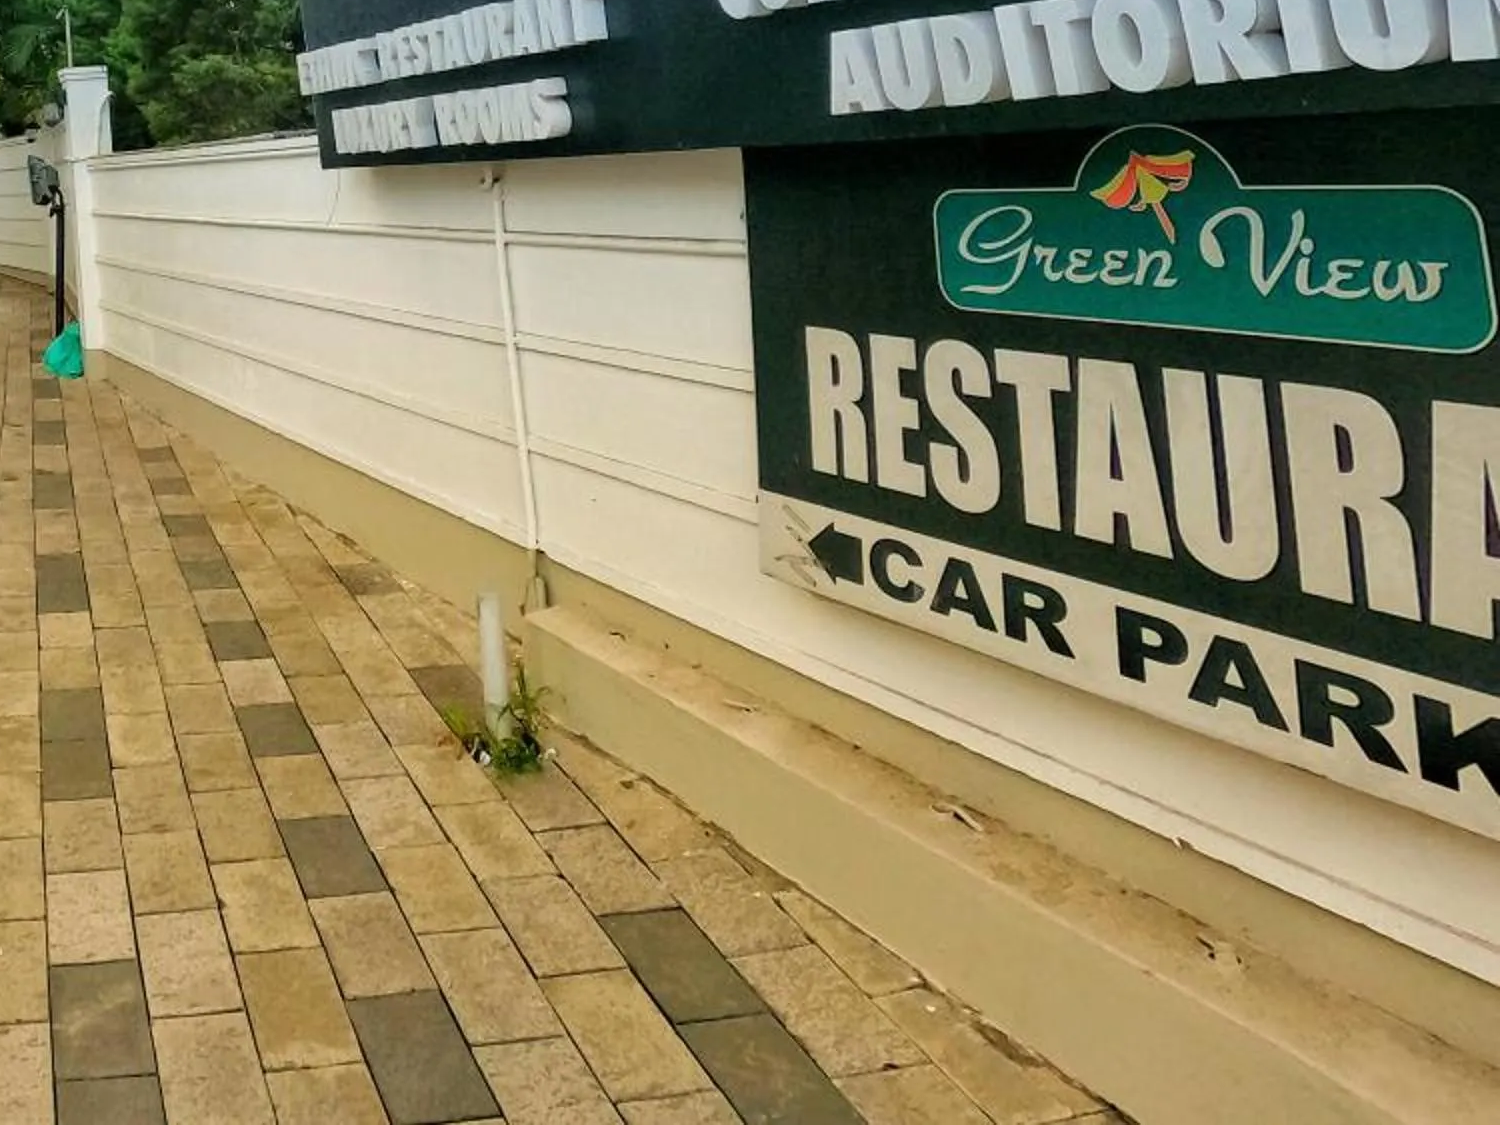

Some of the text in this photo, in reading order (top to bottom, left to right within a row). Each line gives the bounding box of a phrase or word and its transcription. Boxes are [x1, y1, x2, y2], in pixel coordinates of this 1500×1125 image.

[433, 77, 573, 146] ROOMS
[958, 205, 1449, 303] Green View
[868, 537, 1076, 661] CAR
